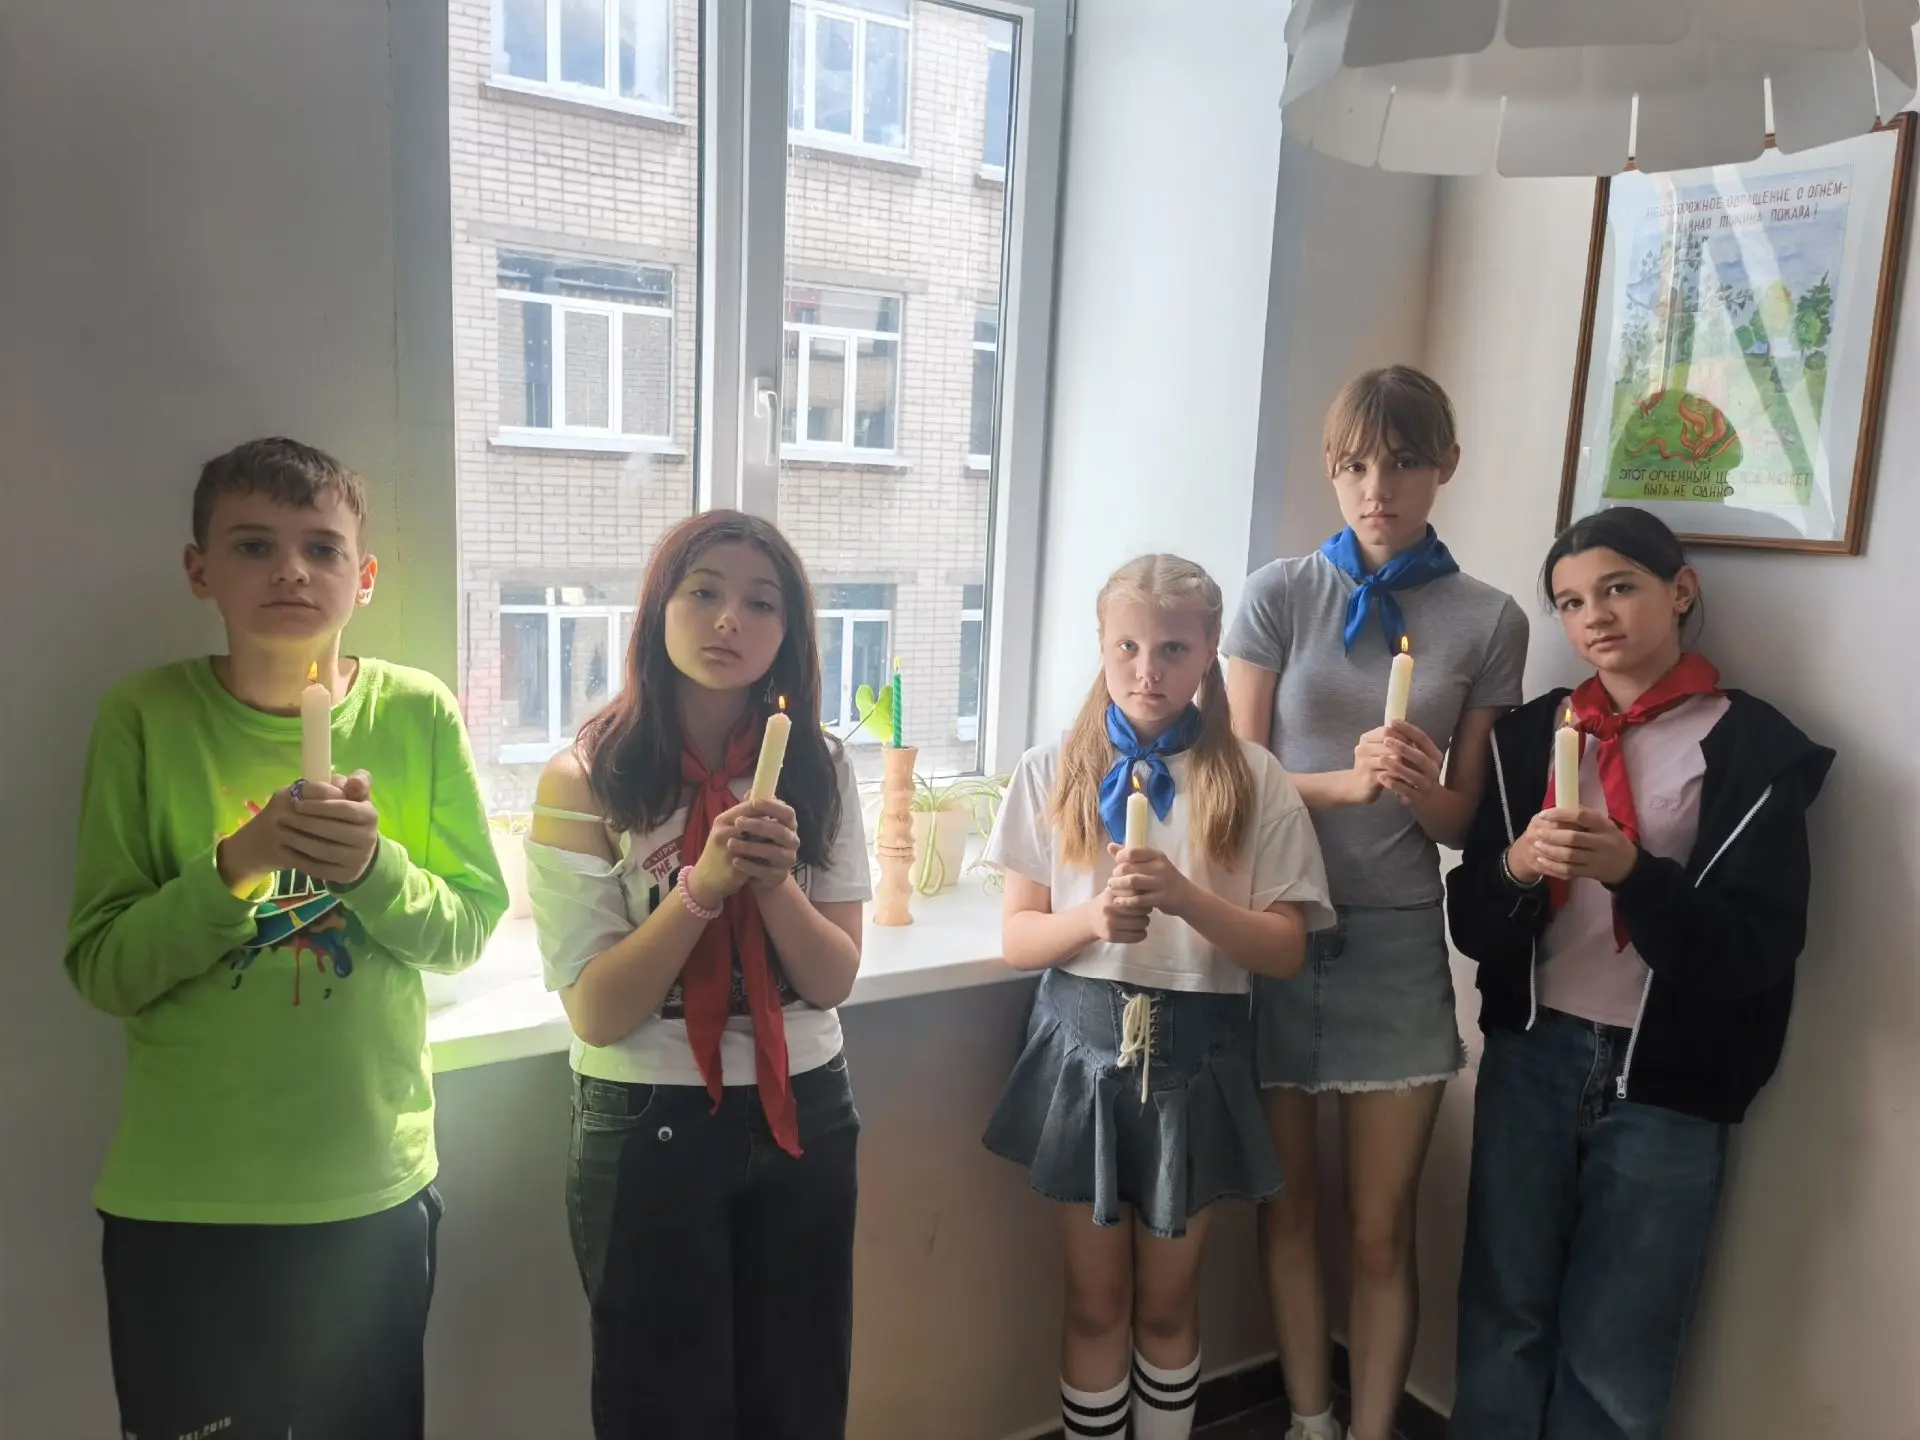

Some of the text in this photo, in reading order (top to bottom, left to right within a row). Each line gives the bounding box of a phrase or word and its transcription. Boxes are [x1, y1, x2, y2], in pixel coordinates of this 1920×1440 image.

[1618, 468, 1647, 481] ЭТОТ
[1649, 466, 1711, 484] ОГНЕННЫЙ
[1643, 483, 1669, 497] БЫТЬ
[1673, 484, 1687, 497] НЕ
[650, 858, 673, 883] THE
